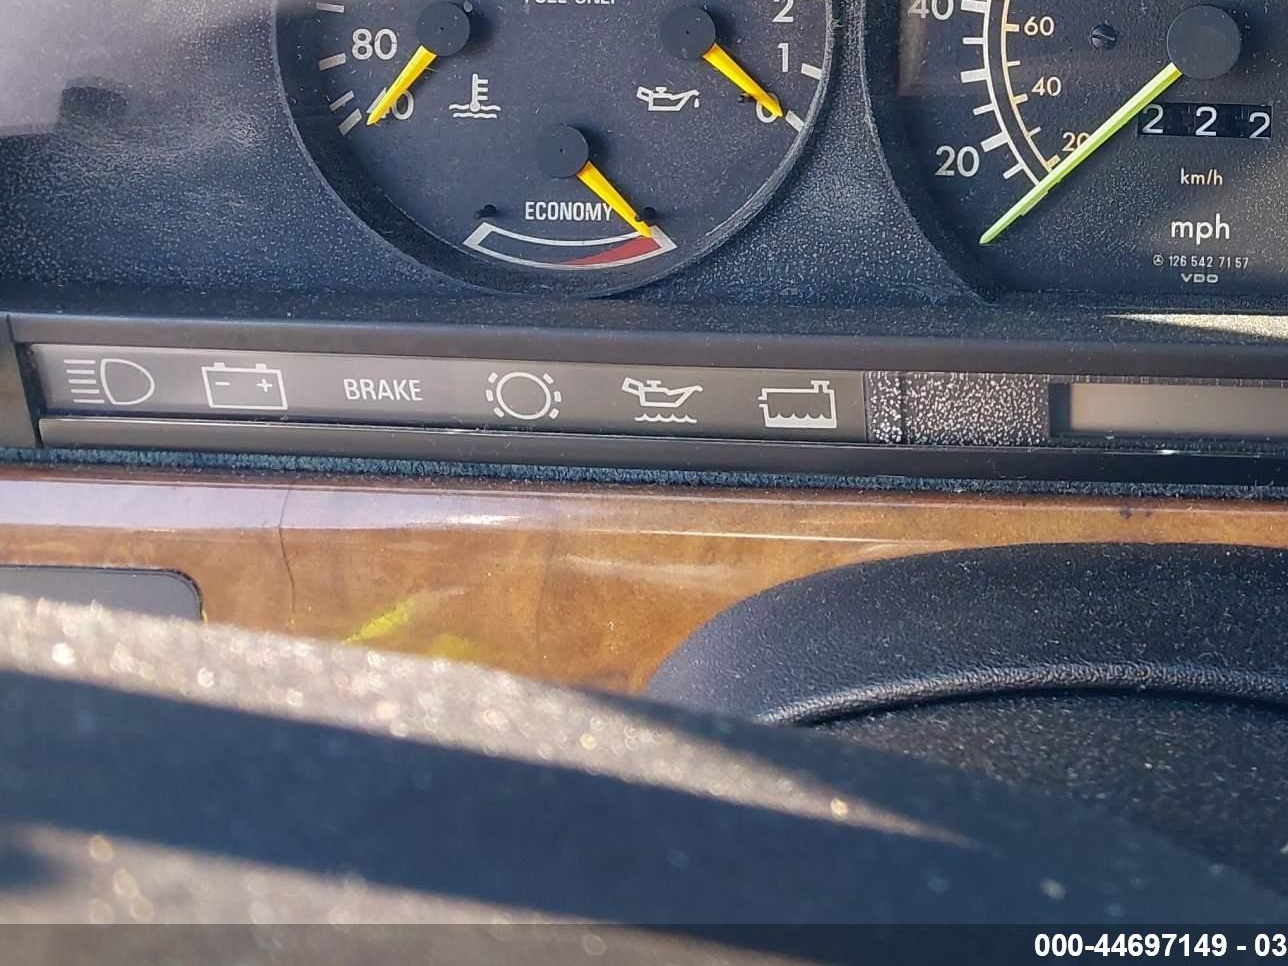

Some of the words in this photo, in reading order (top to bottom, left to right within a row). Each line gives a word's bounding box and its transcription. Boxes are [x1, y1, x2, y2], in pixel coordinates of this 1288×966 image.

[1024, 16, 1055, 36] 60
[351, 28, 397, 60] 80
[778, 44, 789, 72] 1
[1032, 76, 1062, 97] 40
[934, 146, 980, 177] 20
[1180, 168, 1223, 186] km/h
[525, 201, 613, 221] ECONOMY
[1171, 213, 1231, 245] mph
[1169, 255, 1187, 267] 126
[1191, 256, 1213, 267] 542
[1181, 273, 1219, 283] VDO
[344, 377, 422, 402] BRAKE
